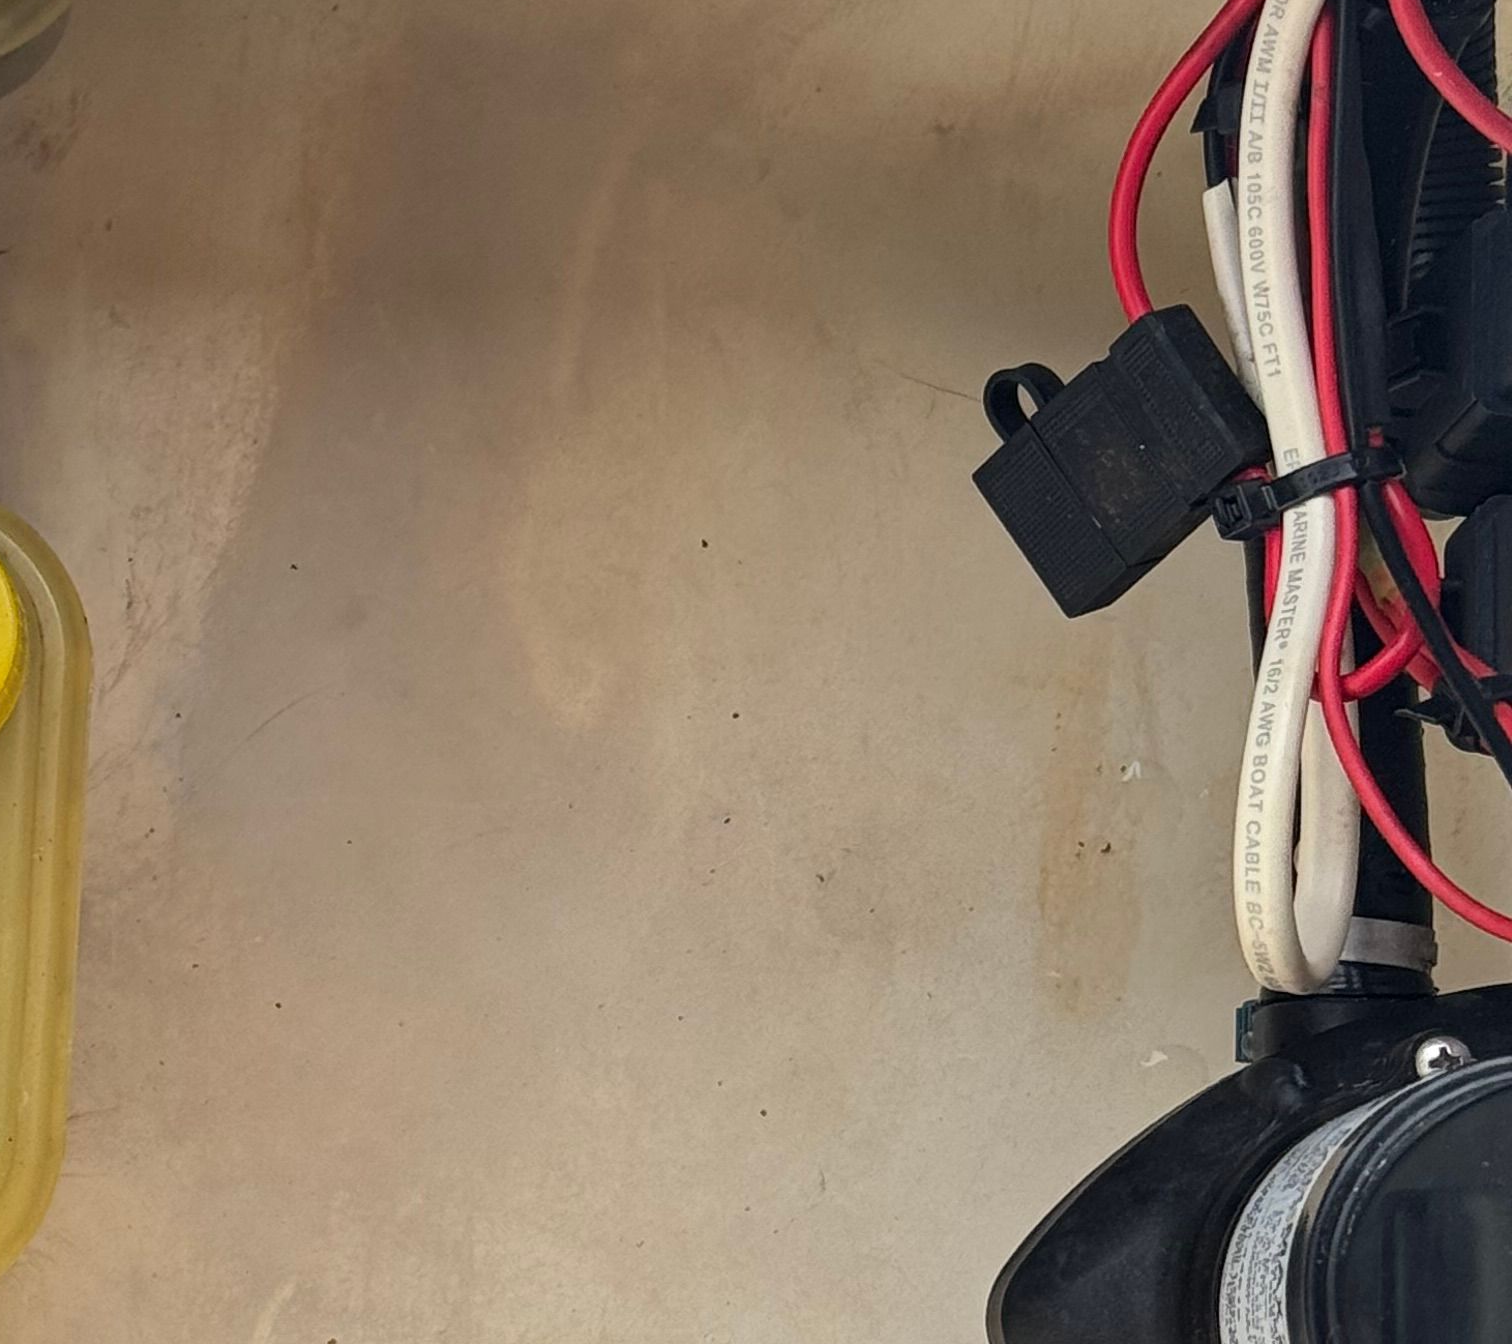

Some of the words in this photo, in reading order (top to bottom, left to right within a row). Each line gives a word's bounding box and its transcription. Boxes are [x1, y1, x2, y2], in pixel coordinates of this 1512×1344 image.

[1256, 24, 1279, 74] AWM
[1247, 131, 1262, 164] A/B
[1246, 173, 1263, 220] 105C
[1247, 227, 1266, 273] 600V
[1252, 281, 1274, 338] W75C
[1262, 343, 1282, 378] FT1
[1262, 659, 1282, 695] 16/2
[1254, 702, 1278, 748] AWG
[1248, 755, 1269, 816] BOAT
[1244, 820, 1262, 893] CABLE
